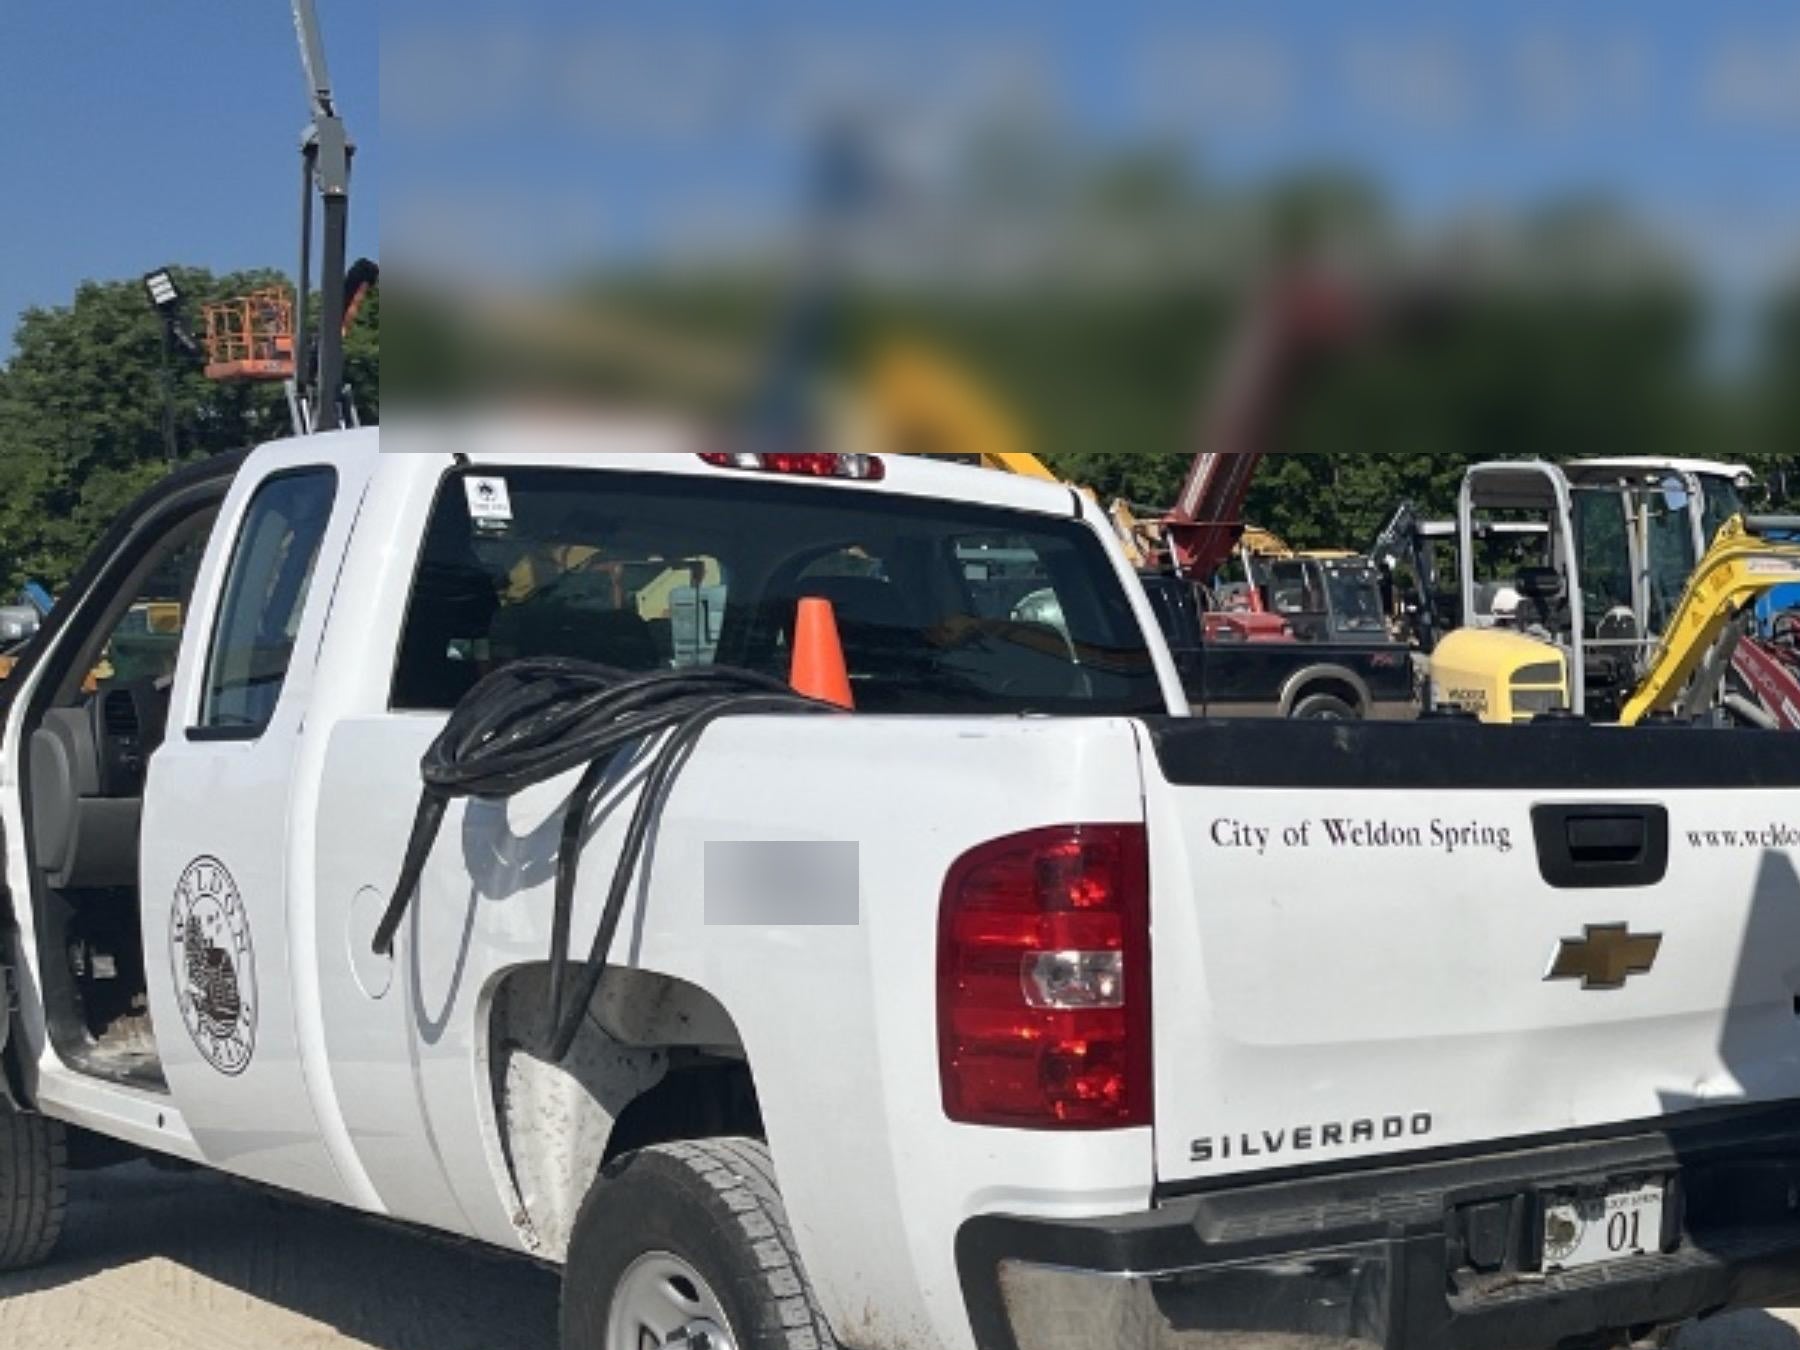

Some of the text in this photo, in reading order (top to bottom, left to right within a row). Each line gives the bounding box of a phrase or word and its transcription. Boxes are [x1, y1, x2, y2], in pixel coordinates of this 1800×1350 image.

[1210, 818, 1512, 855] City of Weldon Spring
[1189, 1112, 1432, 1162] SILVERADO
[1607, 1208, 1640, 1252] 01
